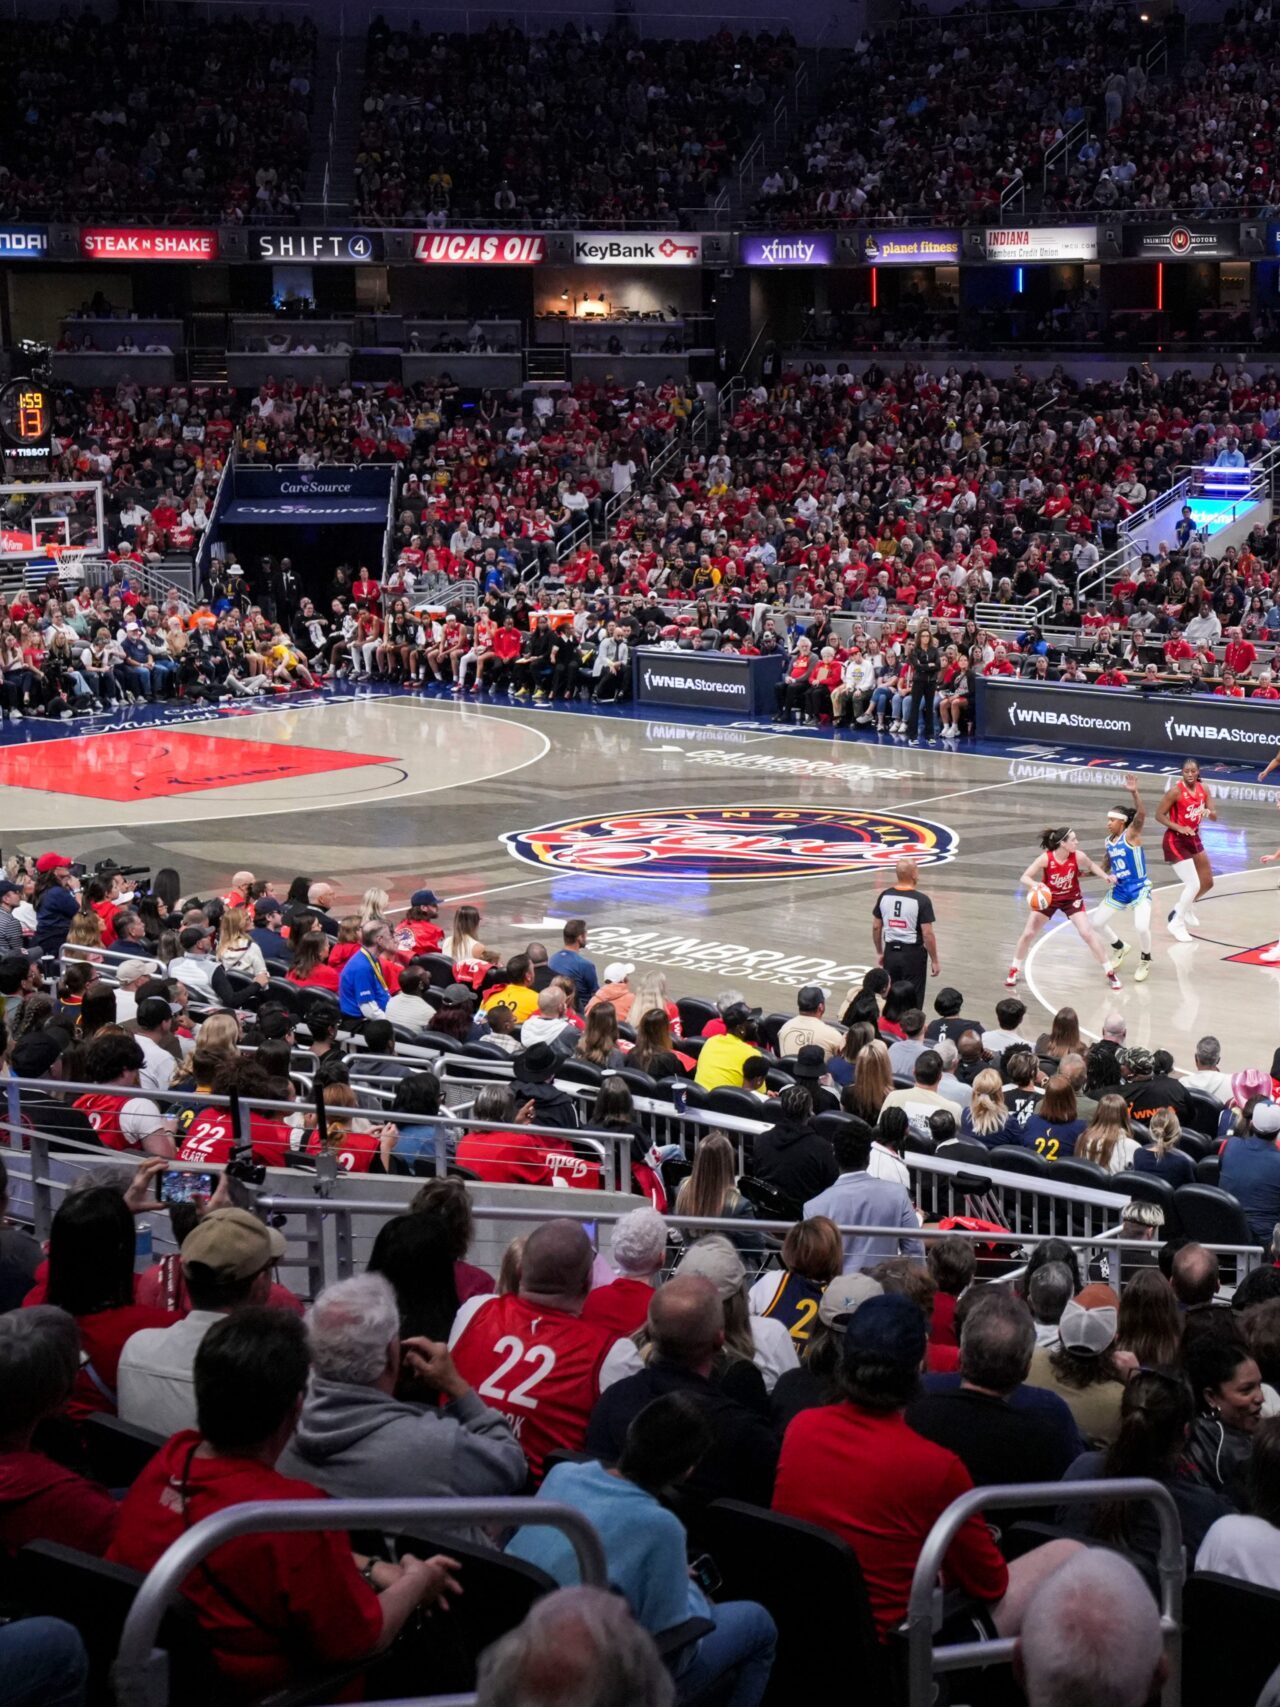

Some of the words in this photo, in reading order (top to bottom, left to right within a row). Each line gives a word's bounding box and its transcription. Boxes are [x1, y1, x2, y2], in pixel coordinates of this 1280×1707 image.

[85, 237, 138, 250] STEAK
[154, 238, 211, 252] SHAKE
[260, 236, 343, 257] SHIFT
[882, 241, 918, 257] planet
[920, 239, 959, 255] fitness
[988, 231, 1029, 246] INDIANA
[415, 236, 498, 261] LUCAS
[503, 238, 545, 261] OIL
[575, 242, 655, 260] KeyBank
[761, 239, 815, 262] xfinity
[1018, 248, 1038, 258] Credit
[1040, 247, 1059, 258] Union
[20, 393, 42, 409] 1:59
[19, 409, 42, 437] 13
[17, 448, 49, 457] TISSOT
[280, 481, 351, 494] CareSource
[651, 674, 746, 695] WNBAStore.com
[1017, 708, 1131, 732] WNBAStore.com
[894, 901, 902, 918] 9
[586, 926, 868, 986] GAINBRIDG
[187, 1122, 226, 1153] 22
[180, 1149, 207, 1163] CLARK
[1035, 1137, 1060, 1161] 22
[478, 1335, 556, 1410] 22
